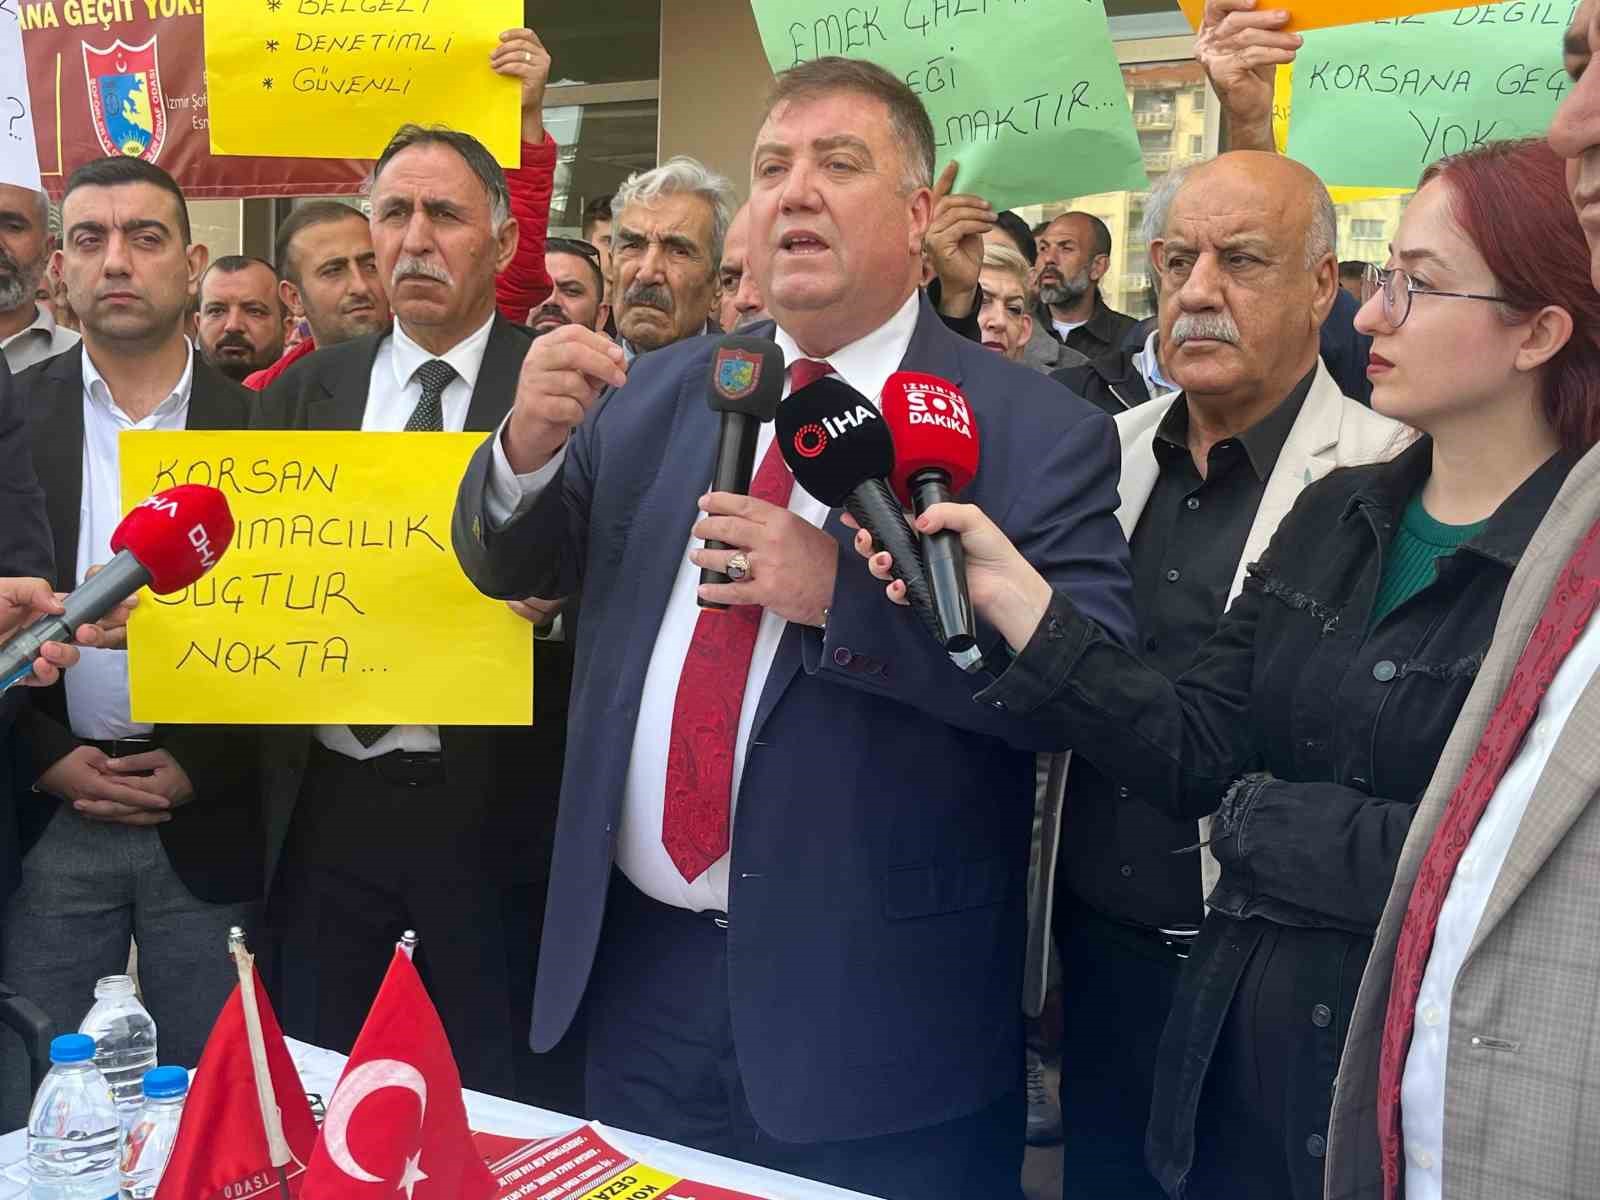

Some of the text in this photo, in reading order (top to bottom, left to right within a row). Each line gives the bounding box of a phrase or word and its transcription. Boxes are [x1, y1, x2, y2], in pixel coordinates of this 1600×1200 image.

[788, 7, 887, 66] EMEK
[292, 67, 413, 96] GÜVENLİ
[1310, 60, 1471, 96] KORSANA
[935, 81, 1115, 147] MAKTIR...
[821, 404, 877, 439] İHA
[907, 392, 970, 427] SON
[152, 457, 339, 495] KORSAN
[223, 1171, 270, 1199] ODASI
